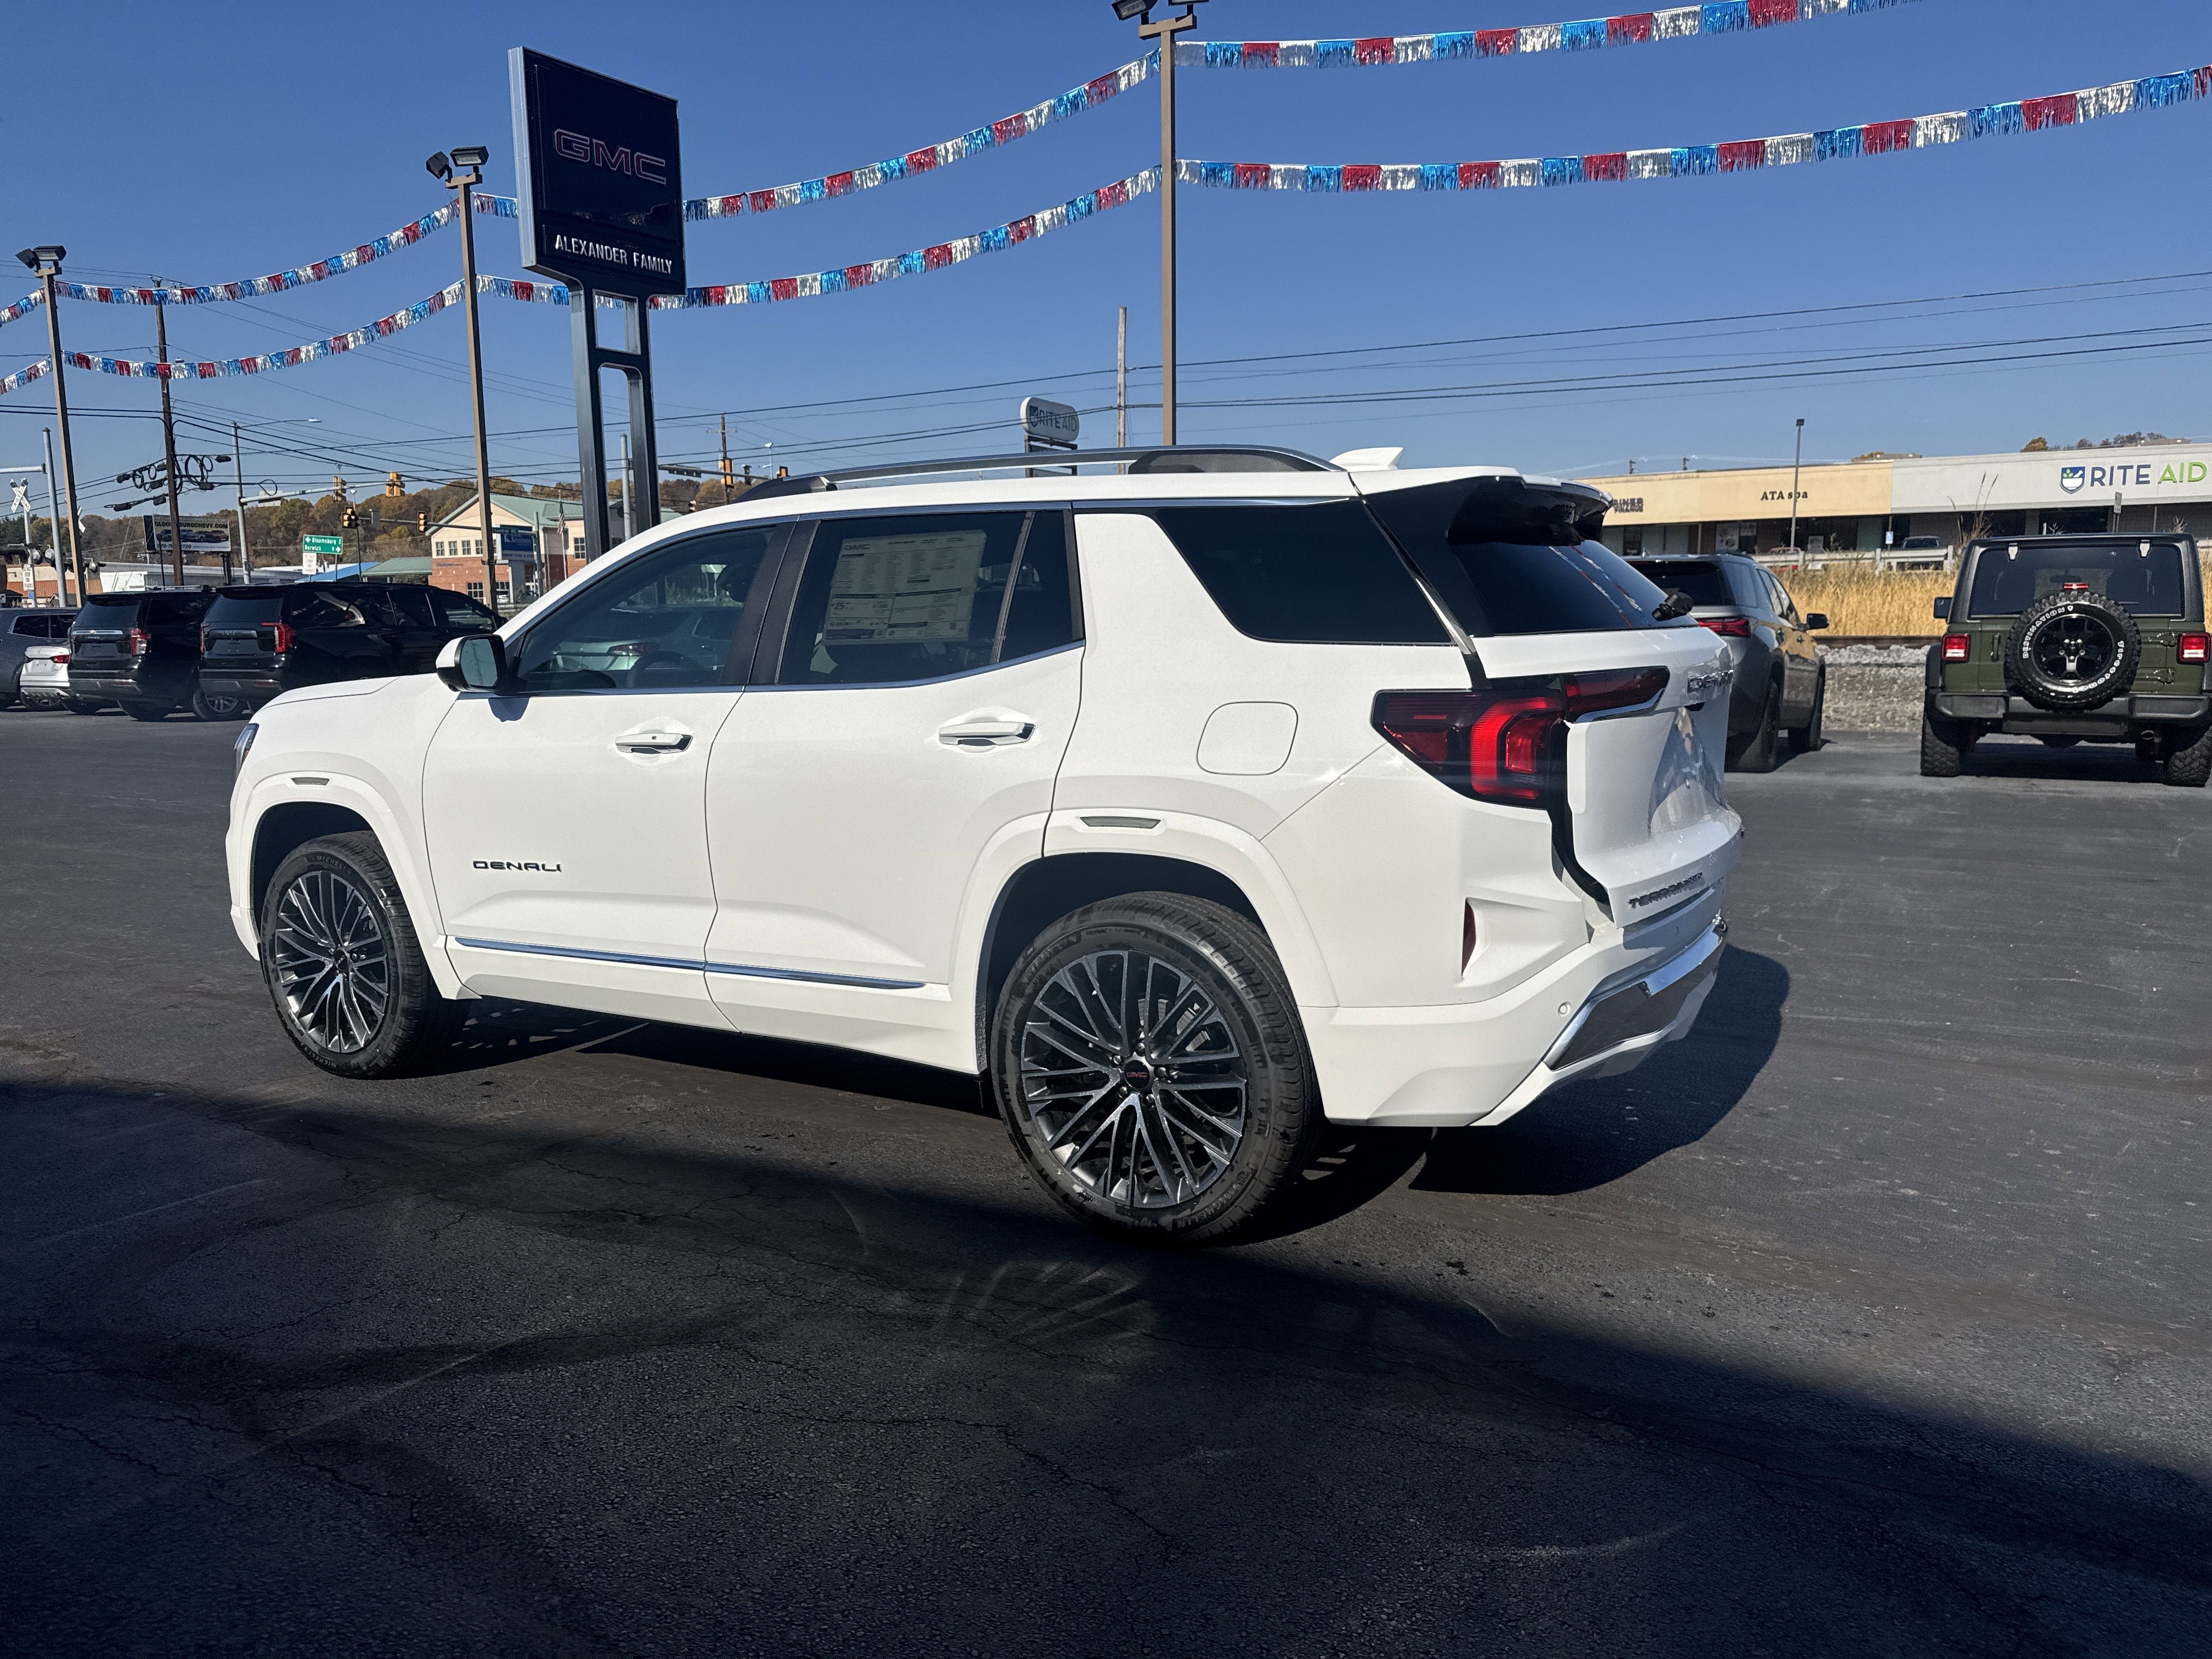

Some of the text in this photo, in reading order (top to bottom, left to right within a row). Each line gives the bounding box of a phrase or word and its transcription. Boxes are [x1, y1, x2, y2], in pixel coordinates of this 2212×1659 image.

[554, 128, 666, 185] GMC
[555, 234, 672, 274] ALEXANDER FAMILY
[1040, 409, 1077, 432] RITE AID
[2090, 461, 2207, 487] RITE AID
[1760, 490, 1808, 502] ATA spa
[2023, 606, 2065, 658] DESTINATION
[473, 860, 562, 872] DENALI
